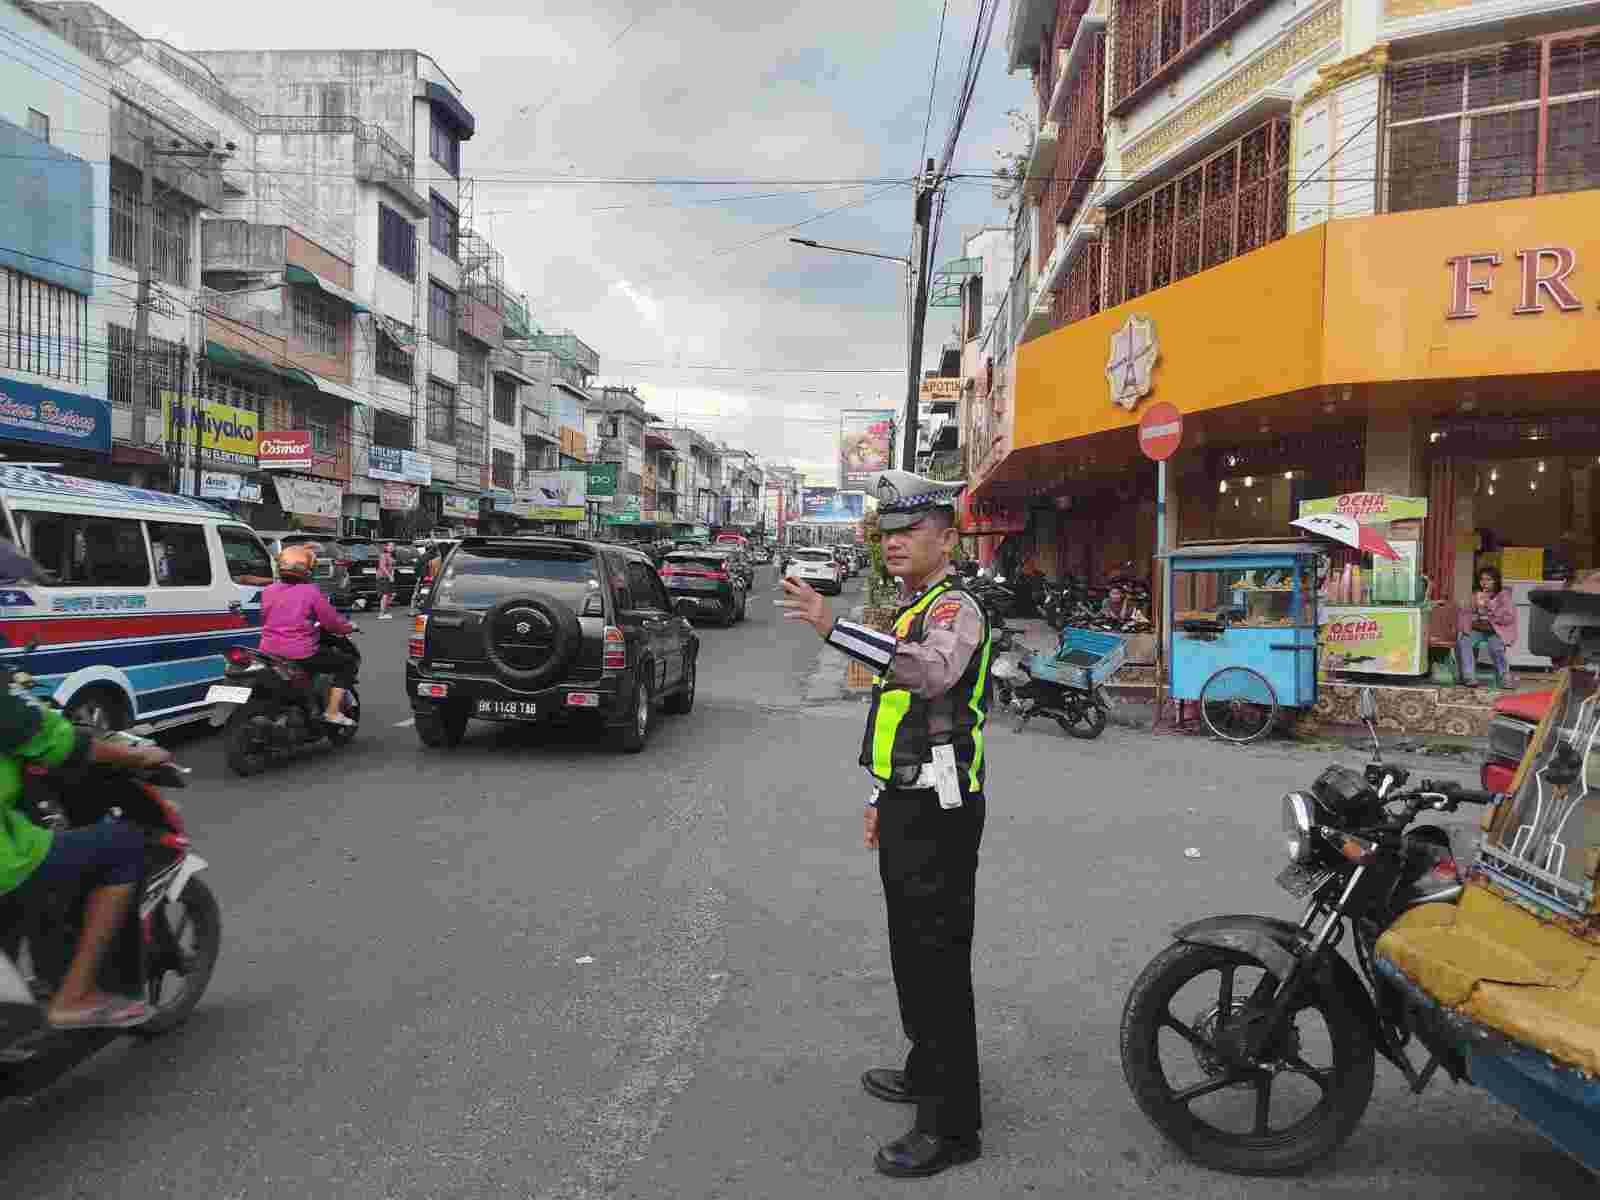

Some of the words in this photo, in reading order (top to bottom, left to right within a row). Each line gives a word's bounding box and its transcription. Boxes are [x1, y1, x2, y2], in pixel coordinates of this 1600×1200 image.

[191, 406, 254, 442] Miyako
[1337, 495, 1384, 507] OCHA
[1331, 622, 1377, 634] OCHA
